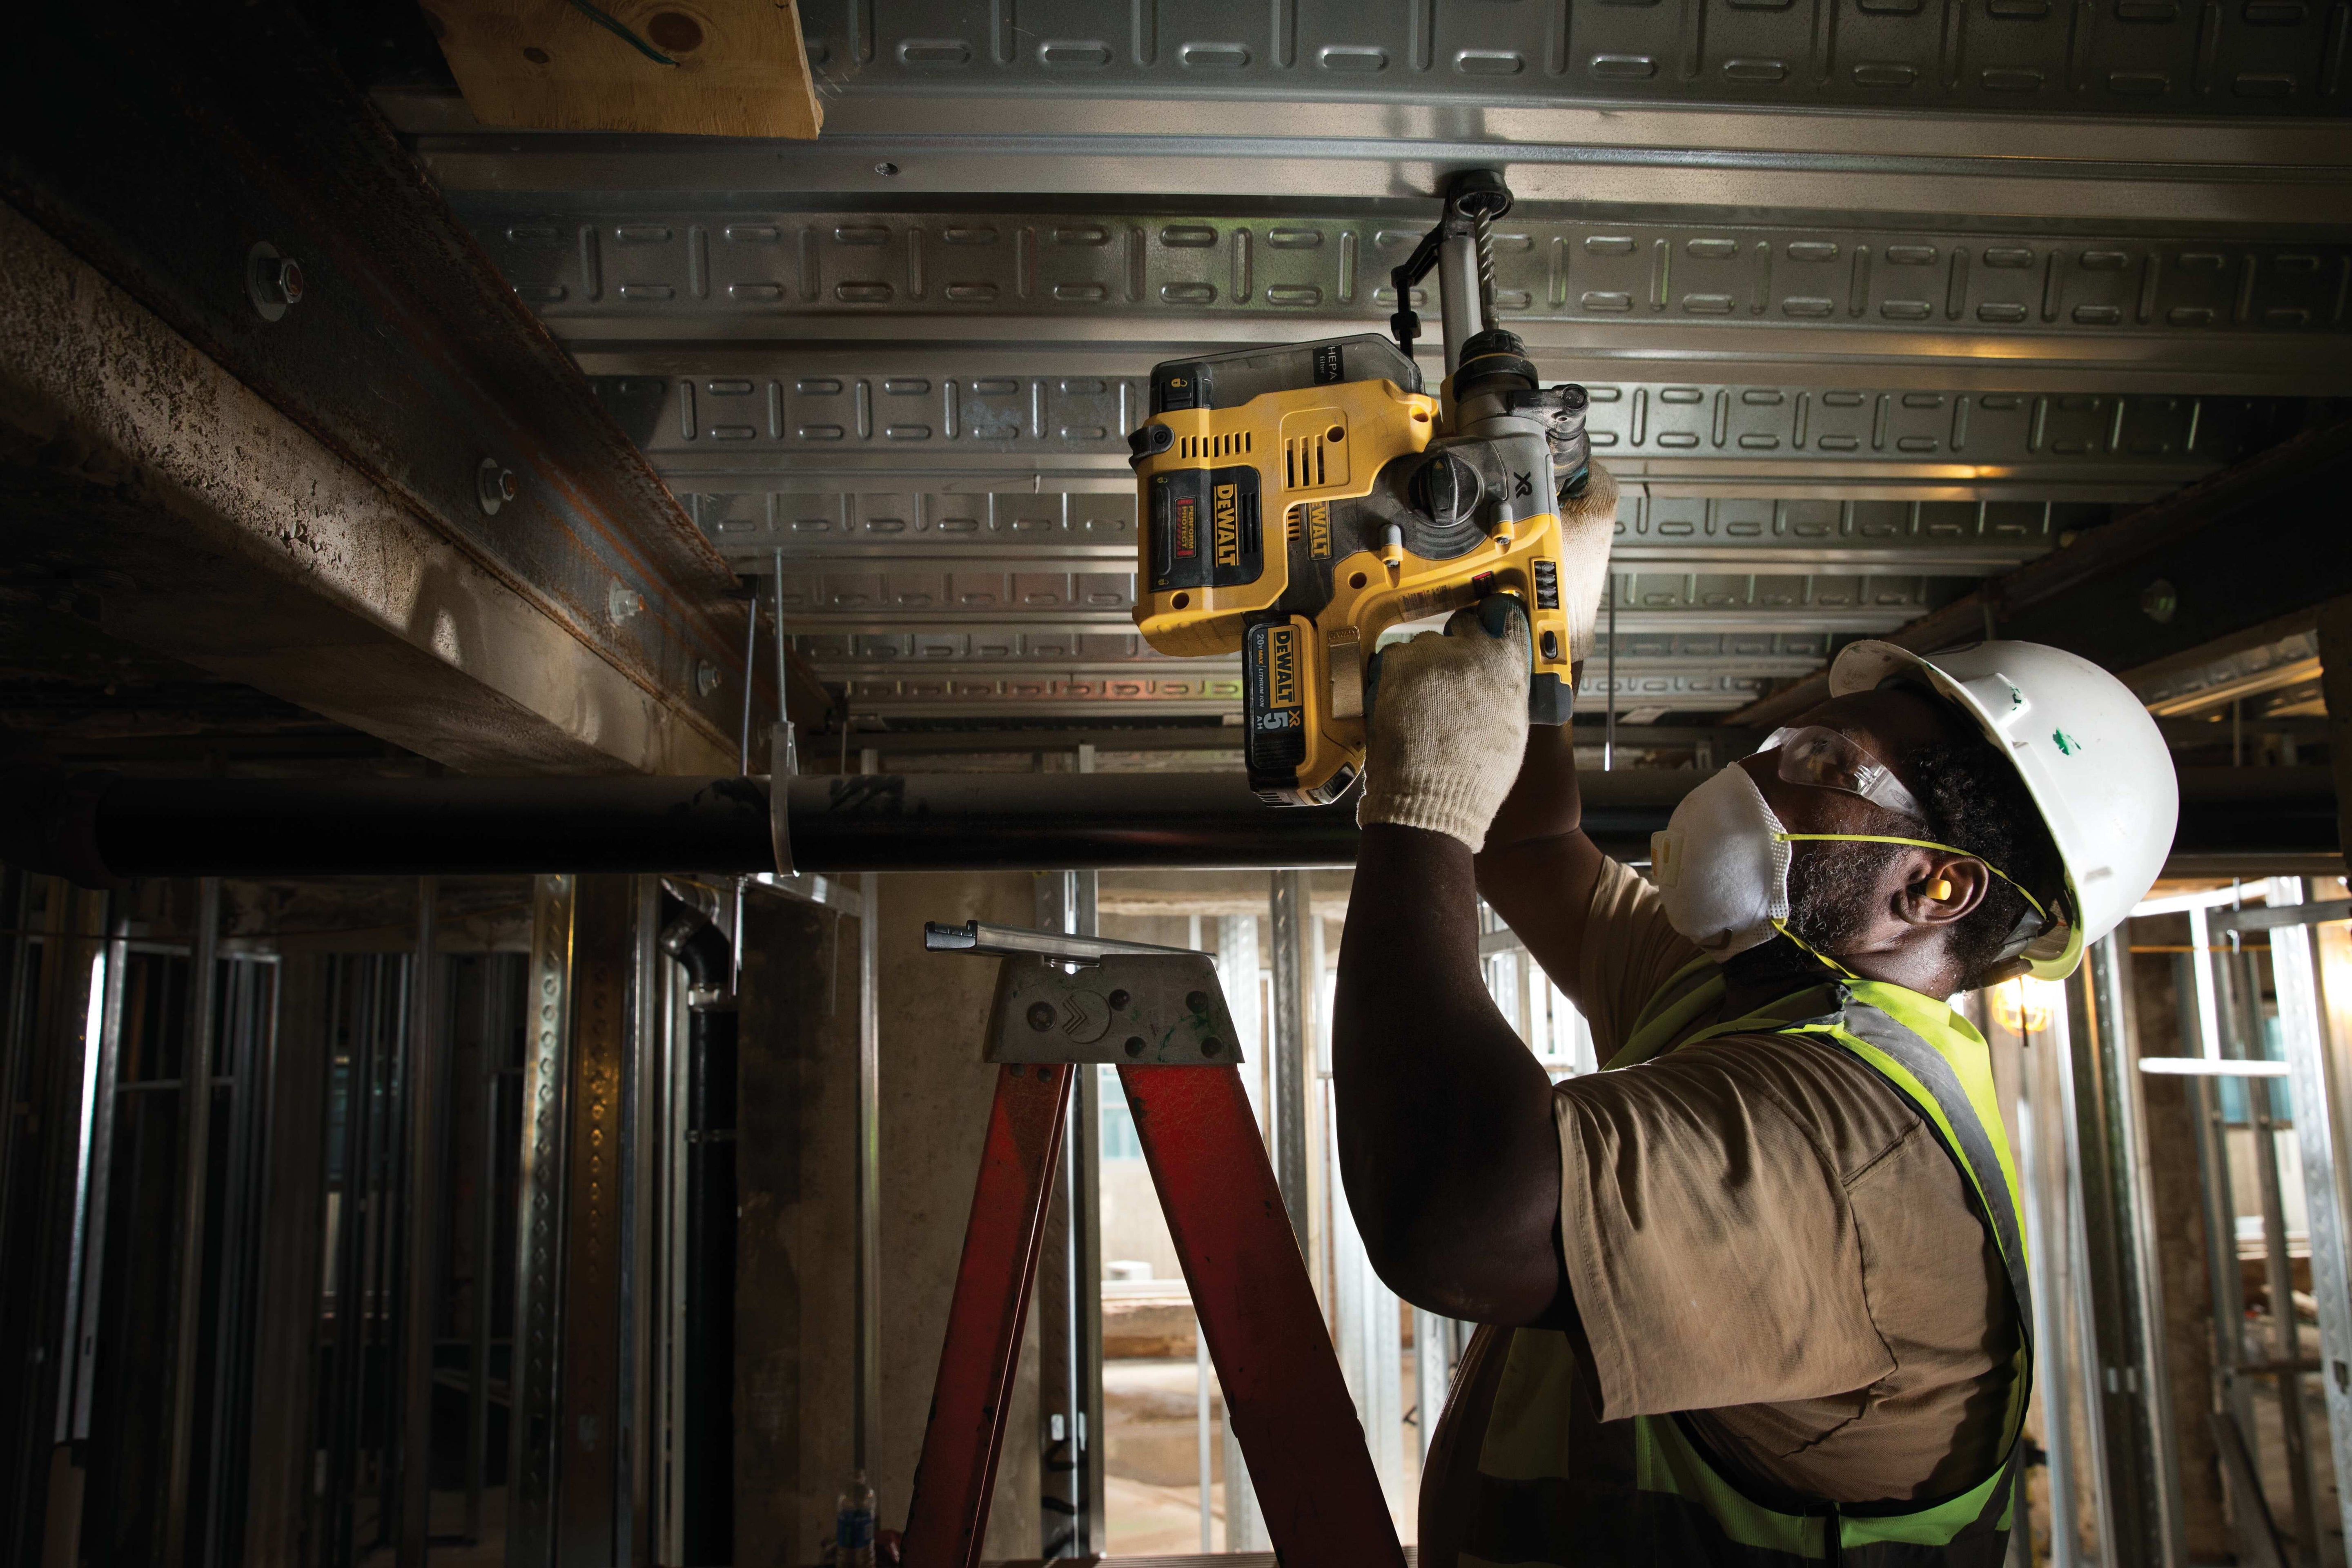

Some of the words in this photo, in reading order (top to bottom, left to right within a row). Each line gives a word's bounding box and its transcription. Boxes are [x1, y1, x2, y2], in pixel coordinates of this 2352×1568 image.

[1328, 346, 1337, 380] HEPA
[1513, 471, 1532, 499] XR
[1217, 484, 1236, 566] DEWALT
[1311, 501, 1327, 556] EWALT
[1276, 630, 1293, 703] DEWALT
[1257, 715, 1263, 729] AH
[1263, 712, 1288, 729] 5
[1289, 710, 1300, 728] XR
